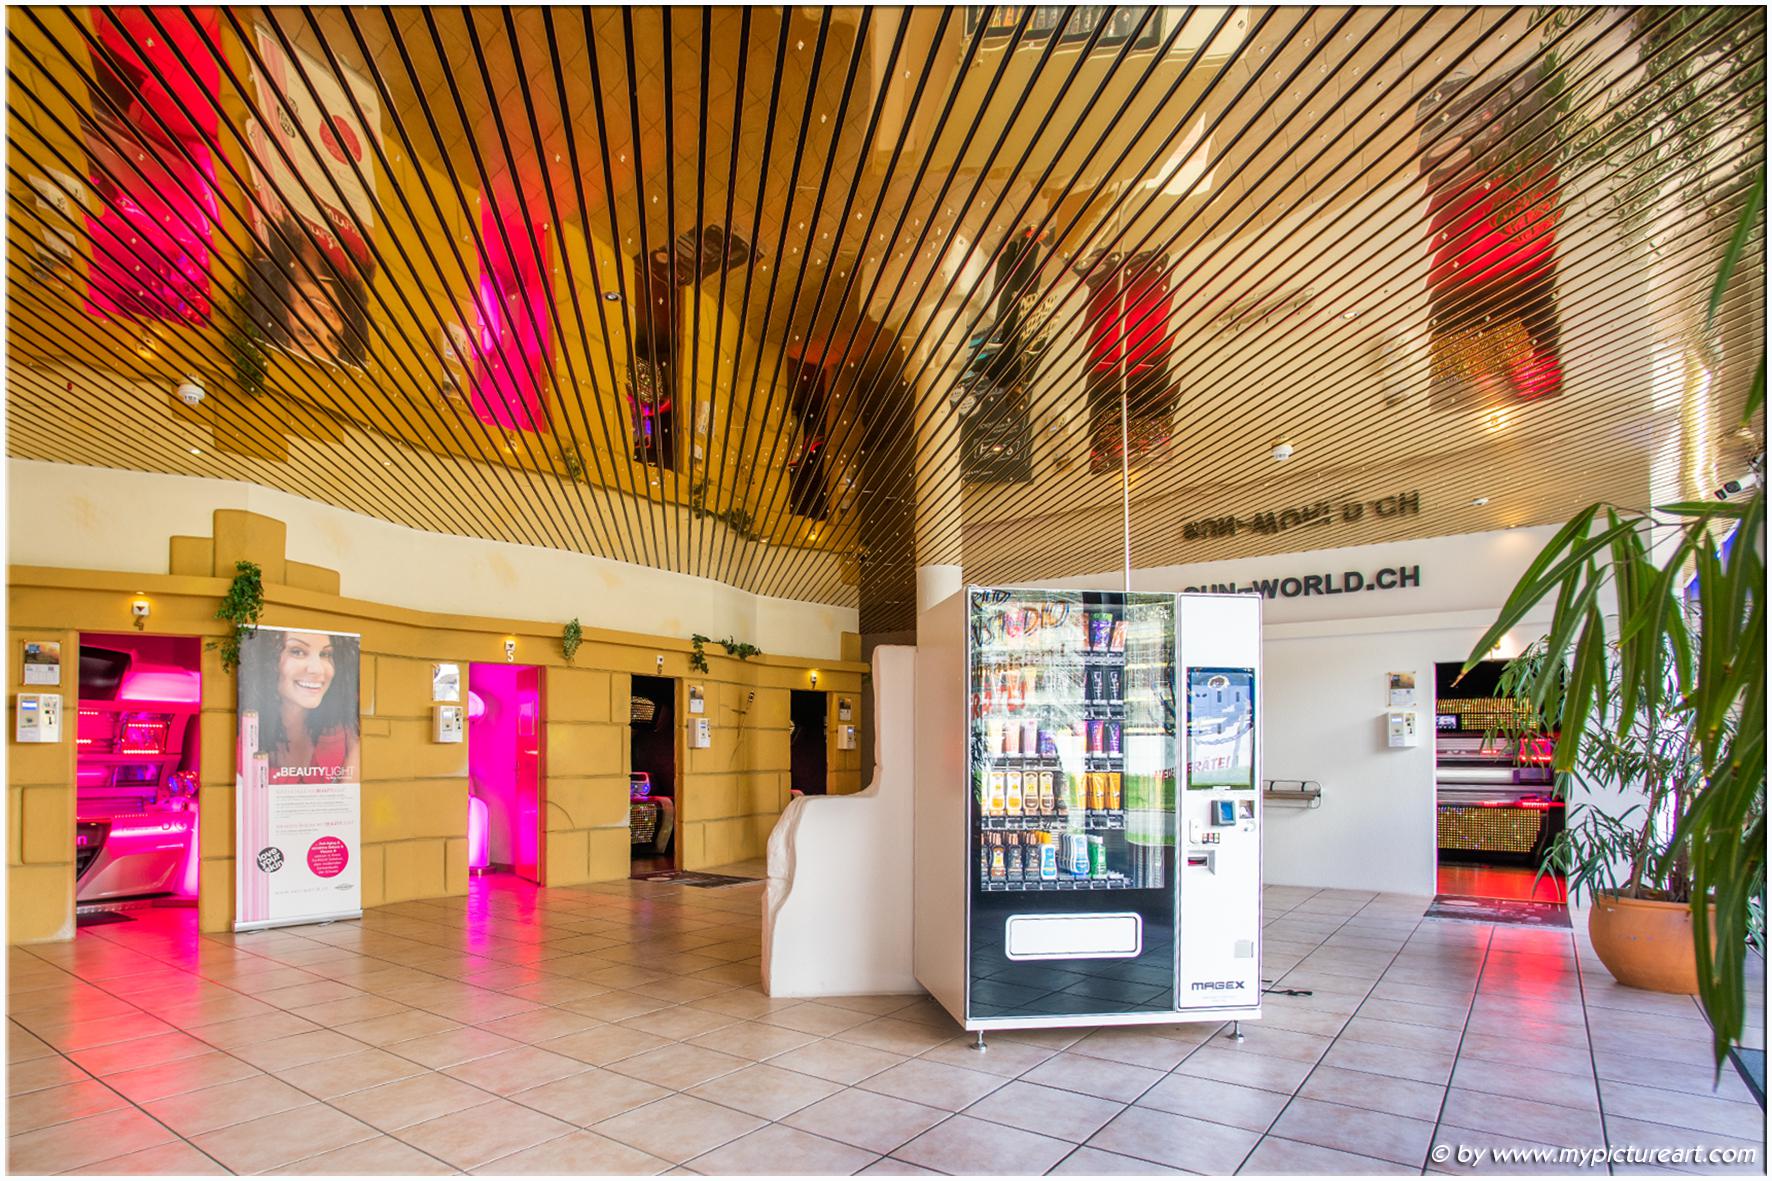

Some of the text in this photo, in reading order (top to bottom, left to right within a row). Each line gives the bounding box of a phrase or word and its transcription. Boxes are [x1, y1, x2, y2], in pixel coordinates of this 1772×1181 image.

[1183, 565, 1420, 599] -WORLD.CH
[507, 650, 514, 662] 5
[280, 766, 355, 777] BEAUTYLIGHT
[257, 848, 278, 862] love
[260, 852, 282, 870] your
[1191, 981, 1245, 991] MAGEX
